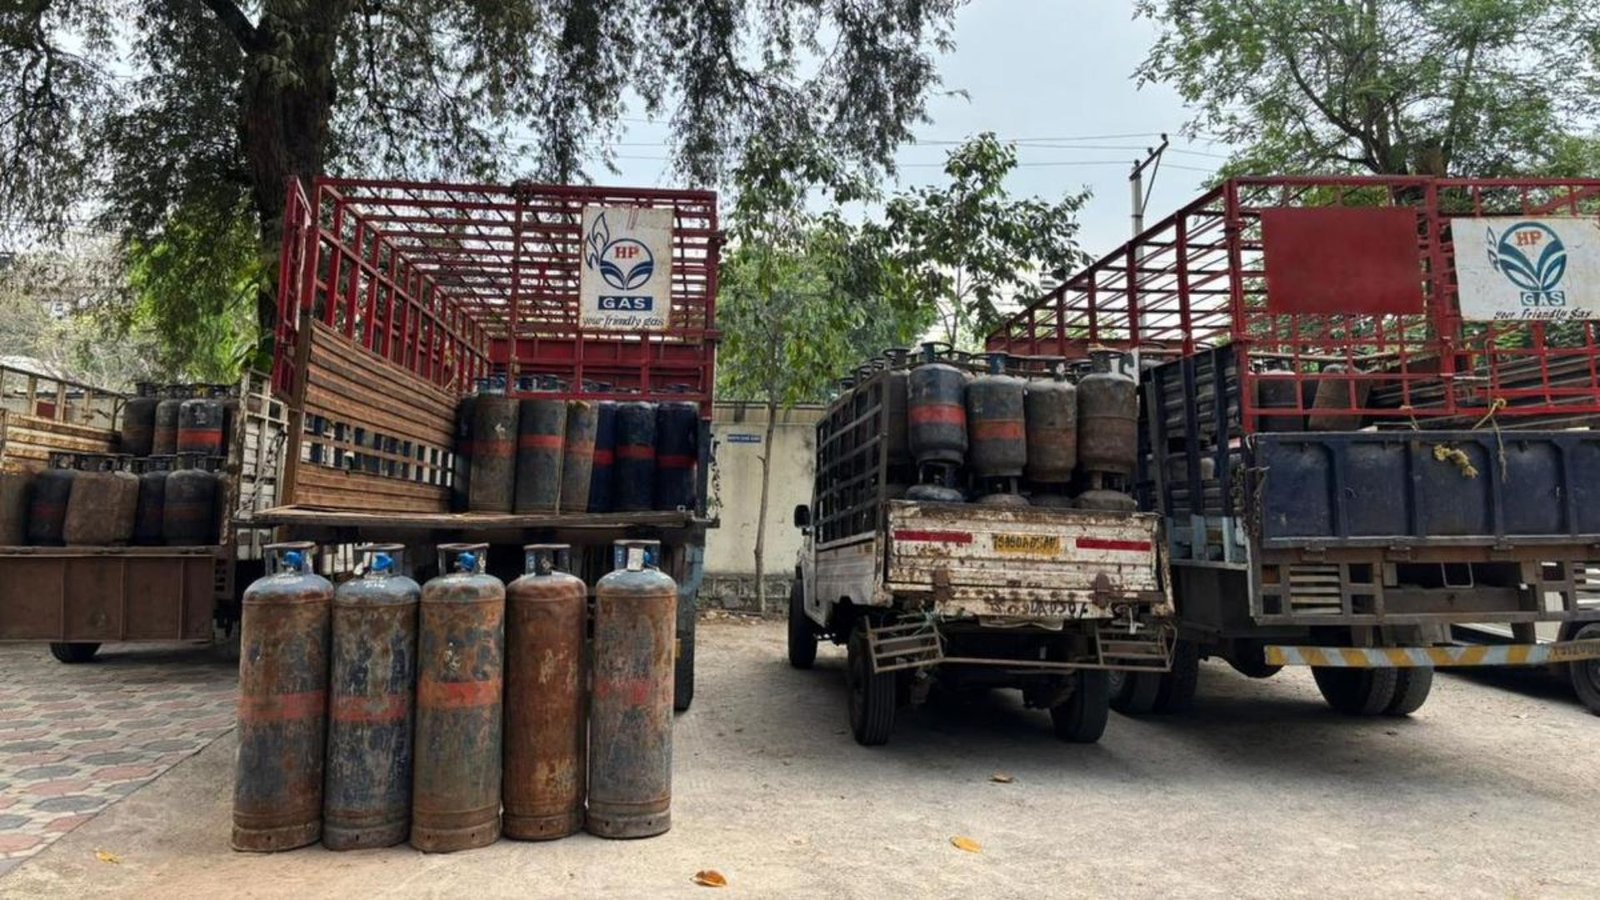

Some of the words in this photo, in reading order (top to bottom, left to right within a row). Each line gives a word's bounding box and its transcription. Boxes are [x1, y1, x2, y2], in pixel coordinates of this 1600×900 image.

[1515, 231, 1542, 246] HP
[614, 246, 640, 259] HP
[602, 297, 647, 309] GAS
[1522, 292, 1564, 306] GAS
